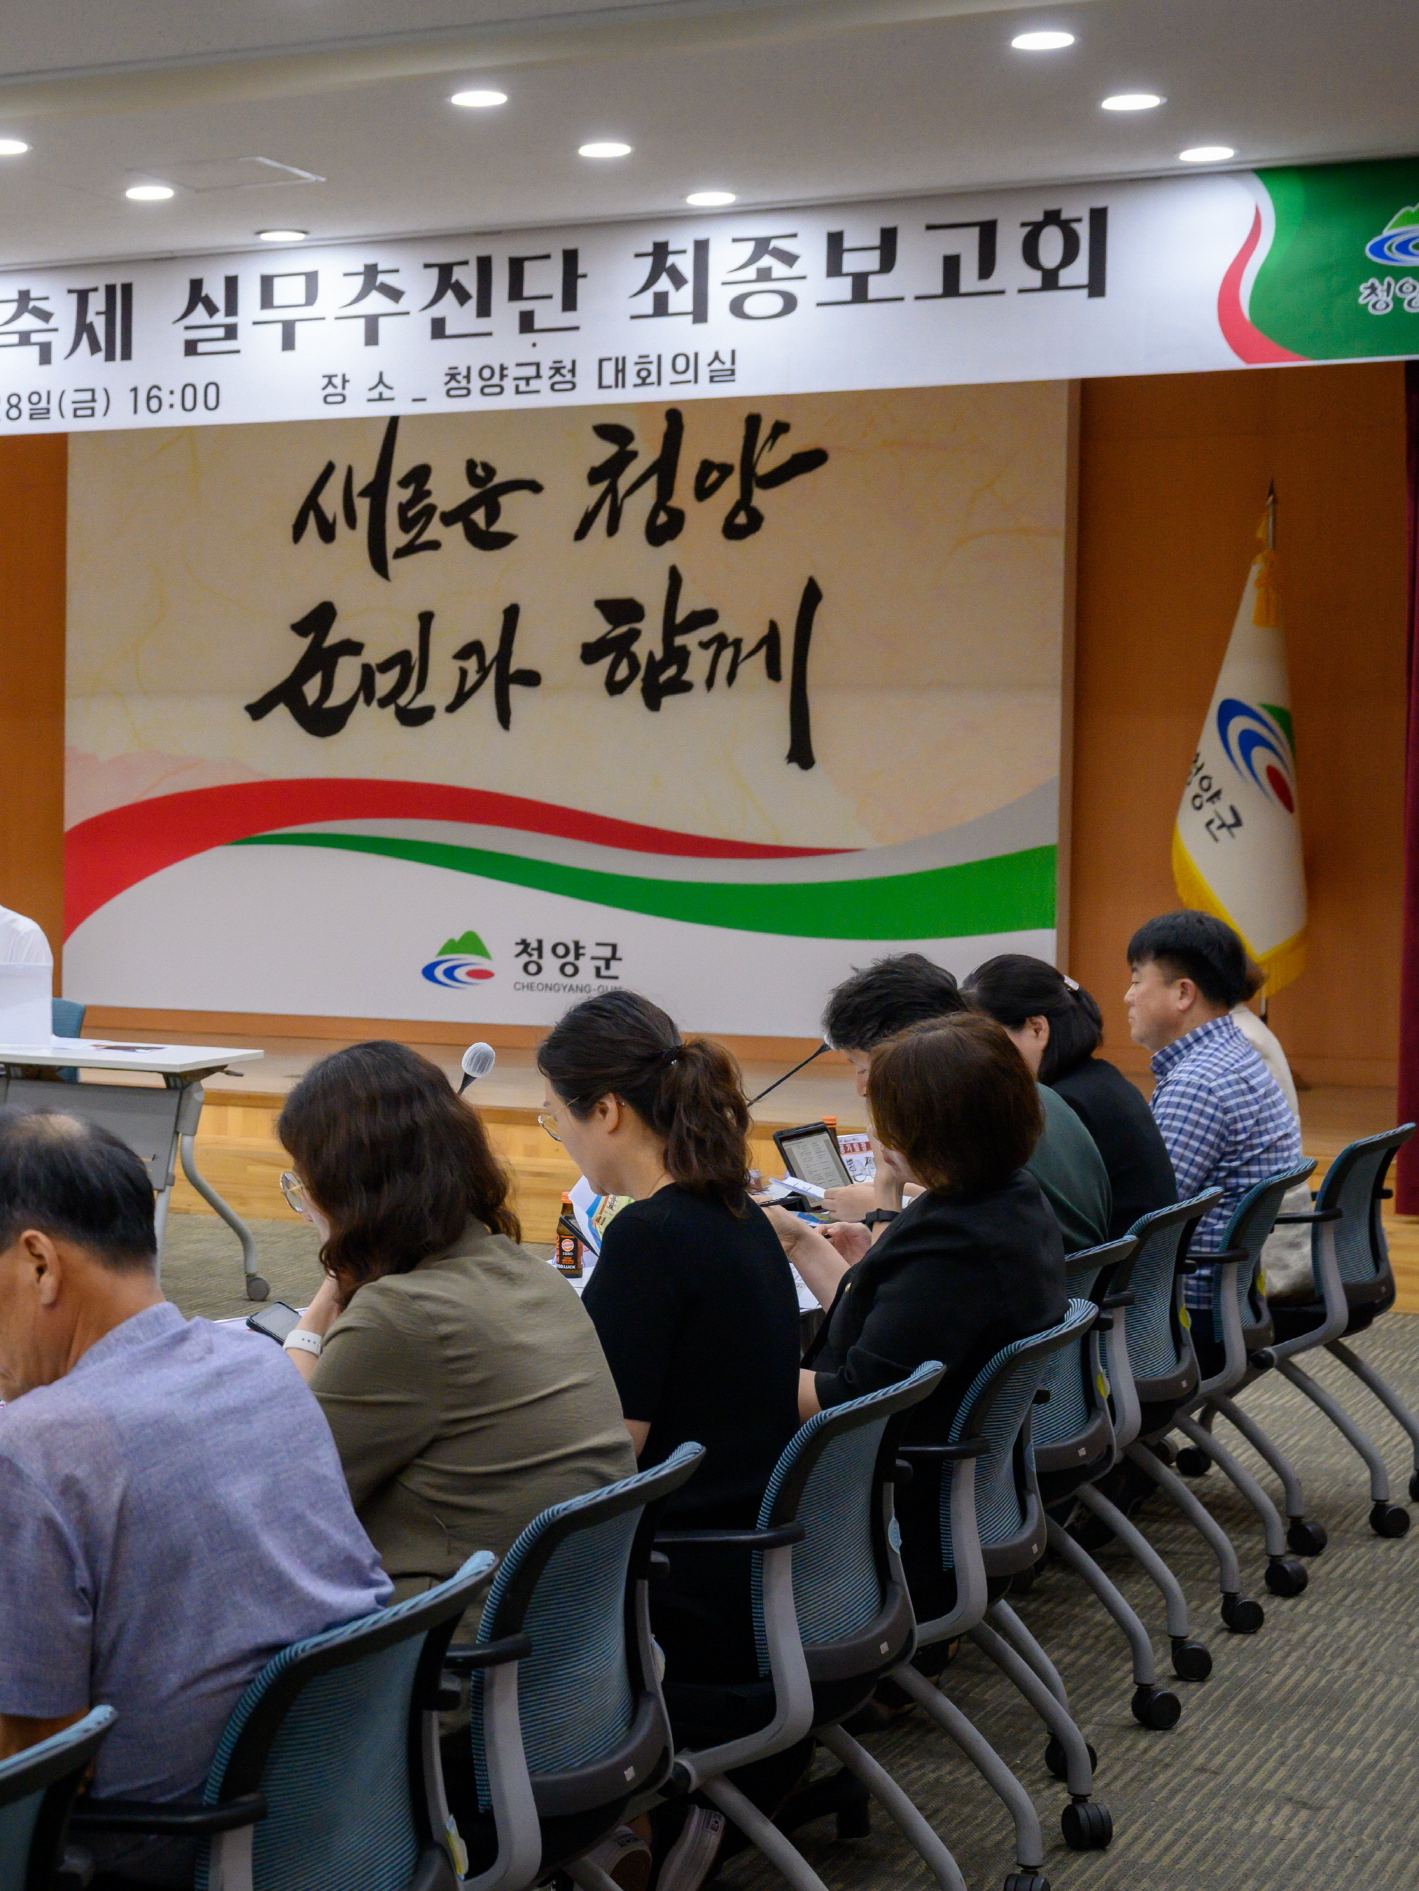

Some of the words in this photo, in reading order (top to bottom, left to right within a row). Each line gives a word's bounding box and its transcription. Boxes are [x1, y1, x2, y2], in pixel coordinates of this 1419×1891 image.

[172, 248, 589, 358] 실무추진단
[627, 205, 1110, 325] 최종보고회
[127, 380, 221, 415] 16:00
[442, 358, 578, 400] 청양군청
[596, 349, 738, 391] 대회의실
[292, 415, 545, 582] 새로운
[574, 407, 830, 547] 청양
[244, 601, 543, 738] 군민과
[580, 563, 823, 771] 함께
[514, 938, 623, 980] 청양군
